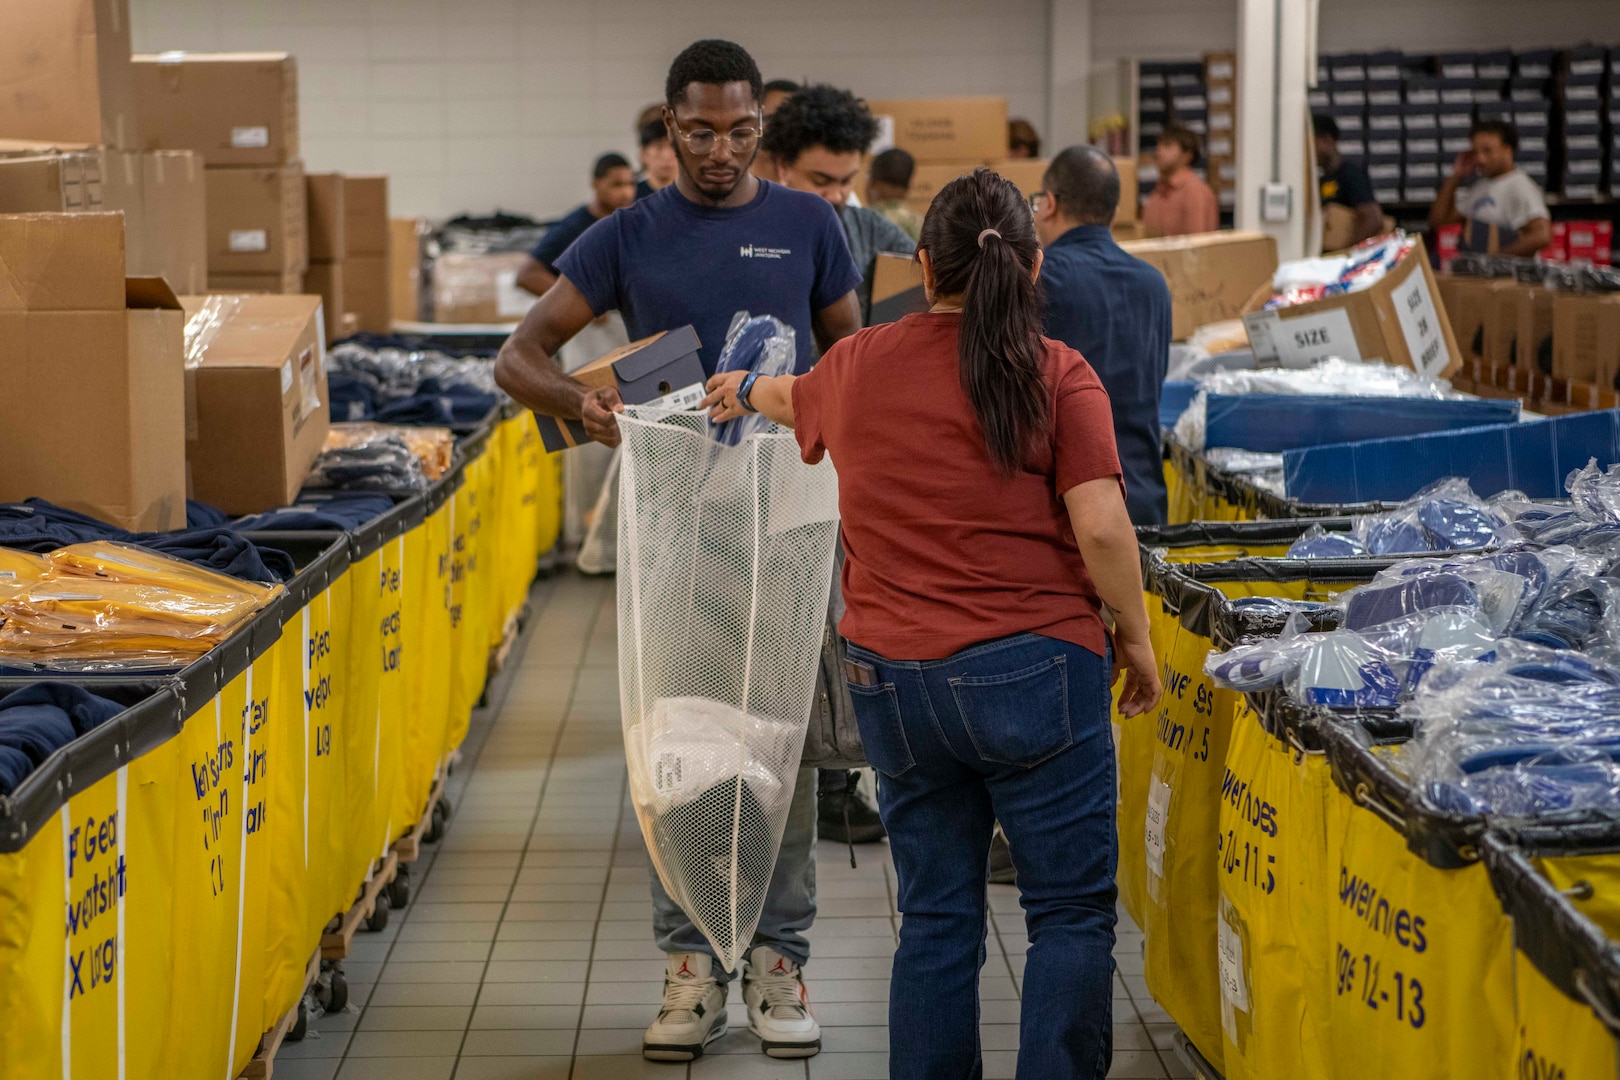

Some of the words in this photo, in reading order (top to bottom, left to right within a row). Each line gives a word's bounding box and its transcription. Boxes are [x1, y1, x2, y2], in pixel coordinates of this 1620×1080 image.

[1407, 285, 1423, 313] SIZE
[1294, 326, 1331, 348] SIZE
[69, 950, 85, 1000] X
